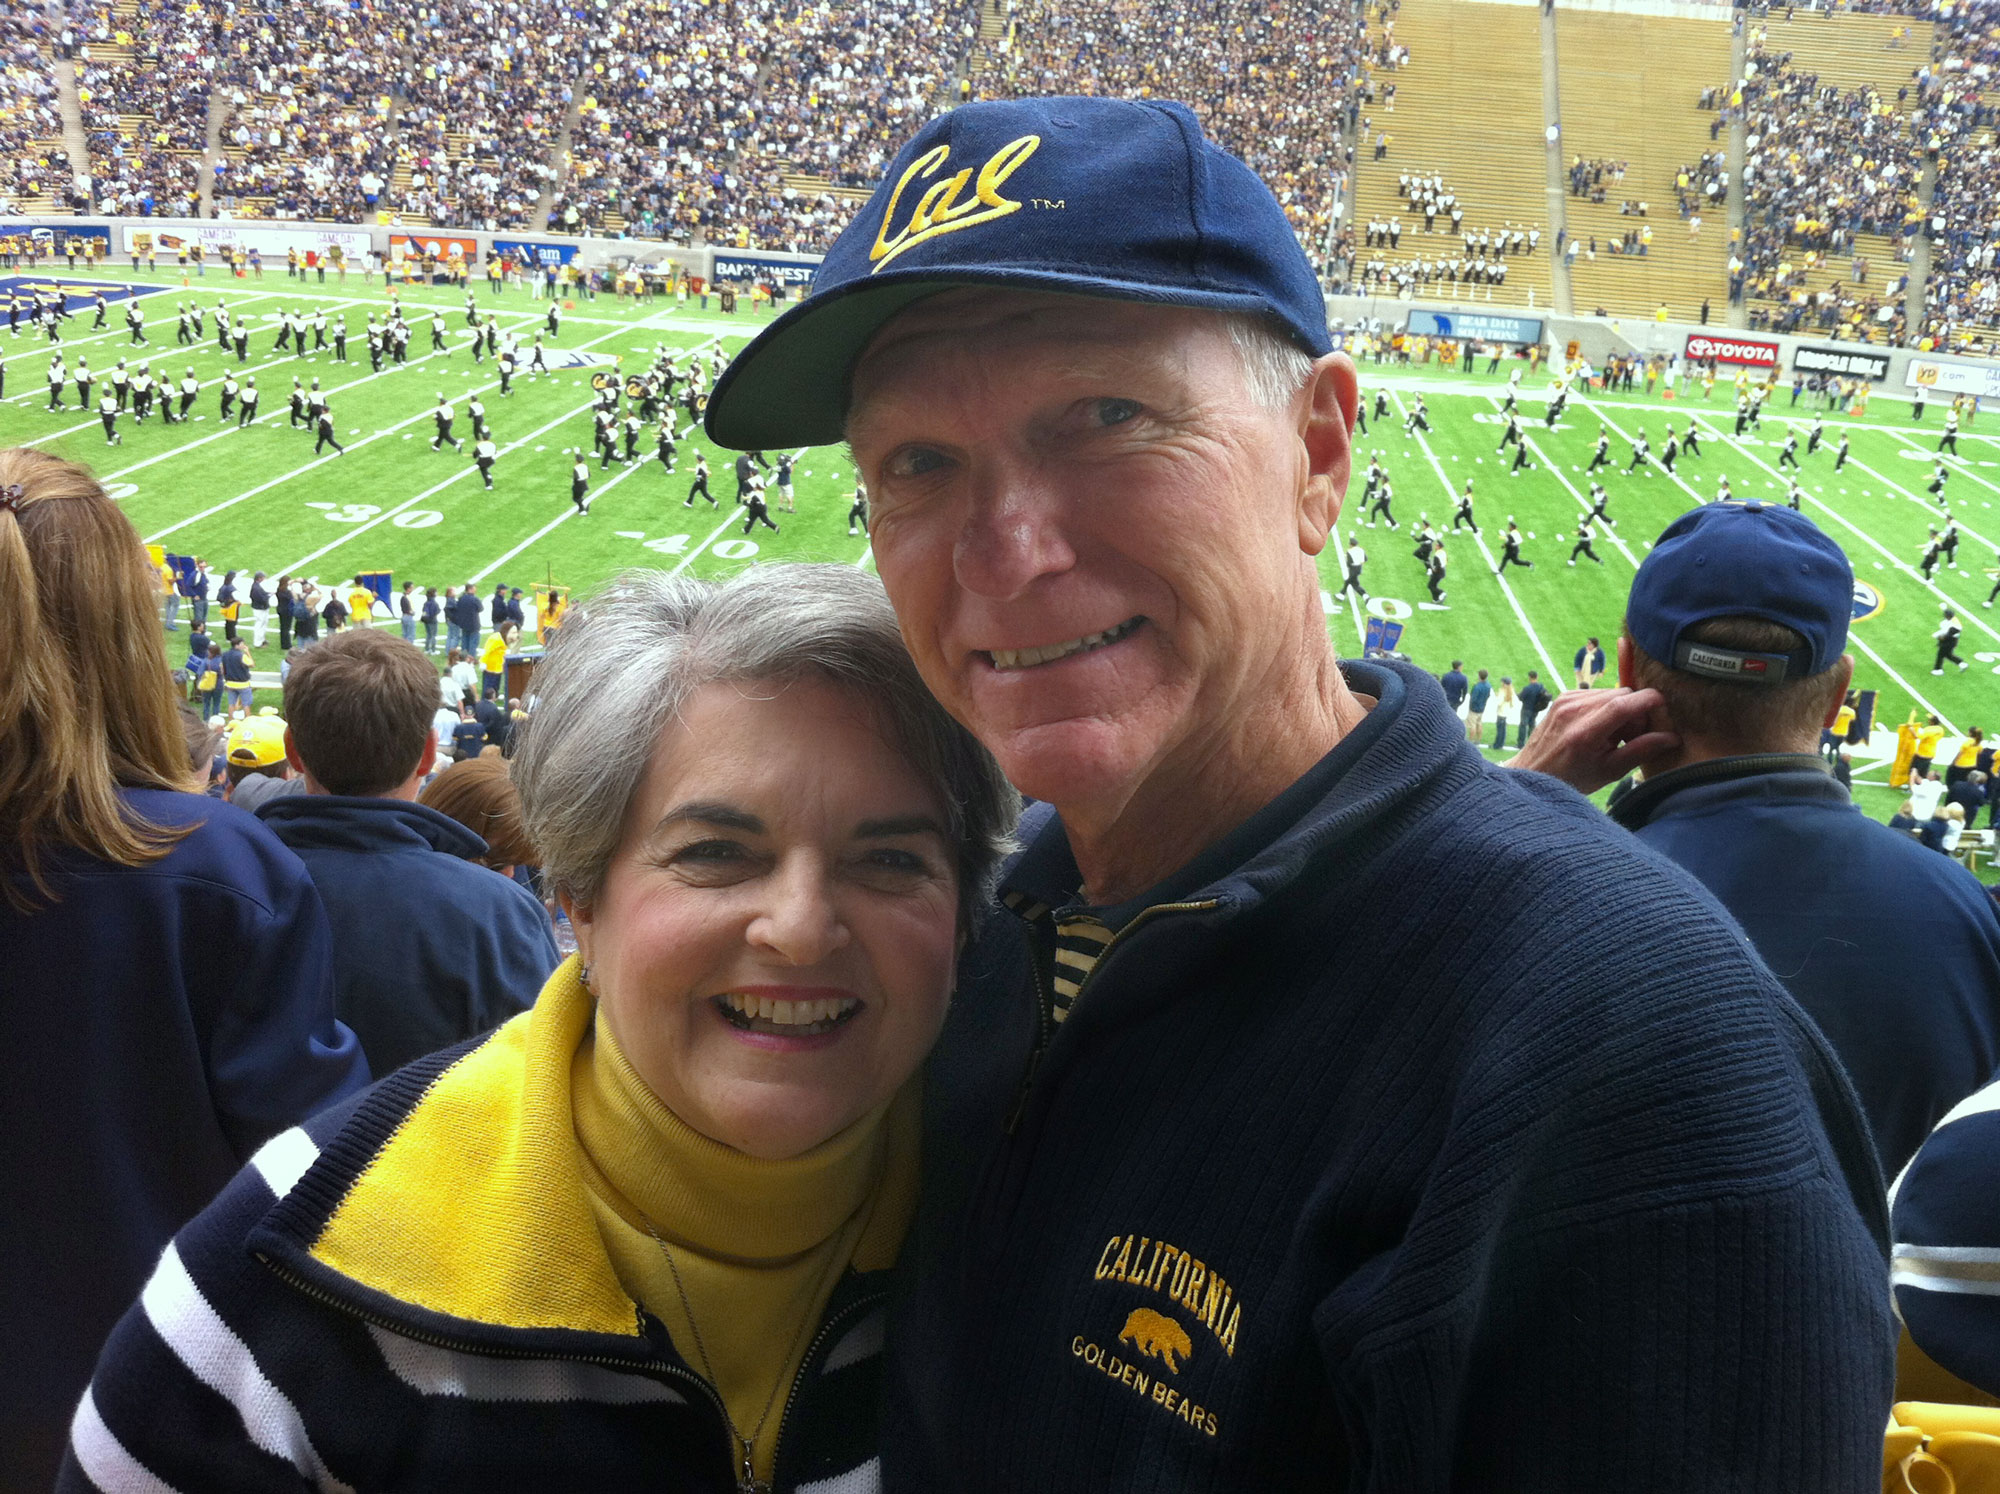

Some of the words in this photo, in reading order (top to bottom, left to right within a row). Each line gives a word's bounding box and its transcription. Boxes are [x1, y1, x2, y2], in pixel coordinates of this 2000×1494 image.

[869, 134, 1041, 275] Cal
[1030, 198, 1065, 210] TM
[1458, 315, 1488, 327] BEAR
[1490, 317, 1519, 330] DATA
[1457, 327, 1519, 341] SOLUTIONS
[1712, 343, 1775, 361] TOYOTA
[1691, 651, 1738, 670] CALIFORNIA
[1095, 1234, 1241, 1358] CALIFORNIA
[1071, 1335, 1150, 1396] GOLDEN
[1152, 1380, 1219, 1436] BEARS
